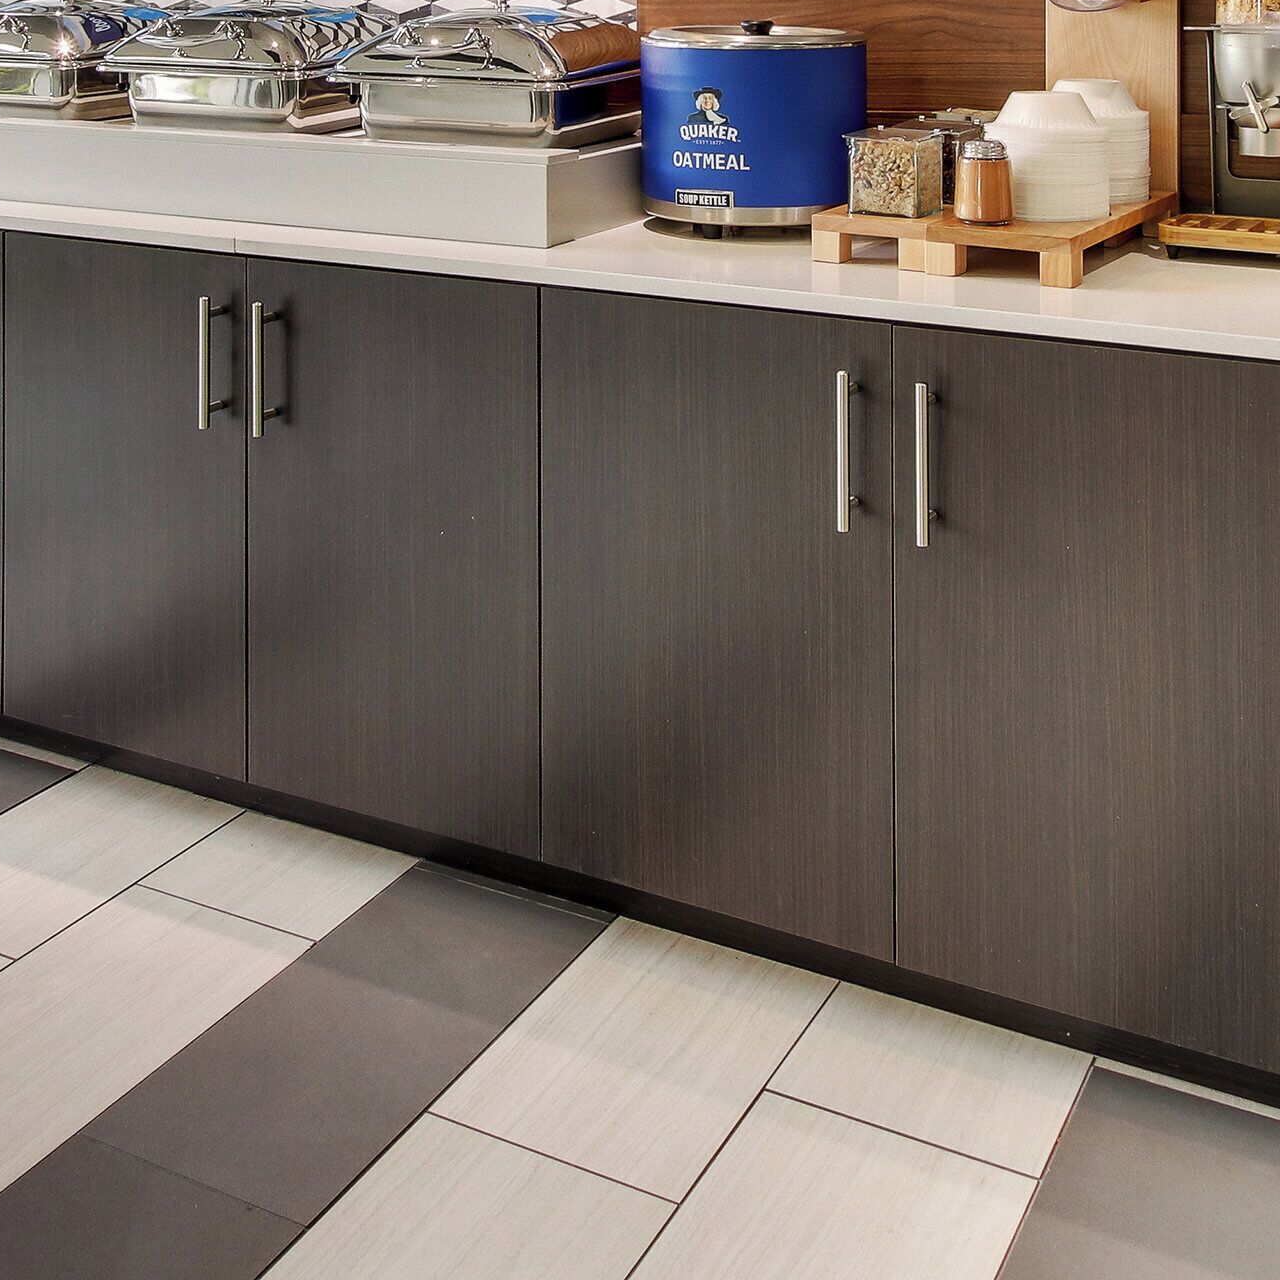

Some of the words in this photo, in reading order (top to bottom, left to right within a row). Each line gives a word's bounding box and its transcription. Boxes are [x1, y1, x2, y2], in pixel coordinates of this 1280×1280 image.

[680, 124, 739, 143] QUAKER
[673, 150, 751, 171] OATMEAL
[679, 193, 699, 204] SOUP
[699, 194, 728, 206] KETTLE
